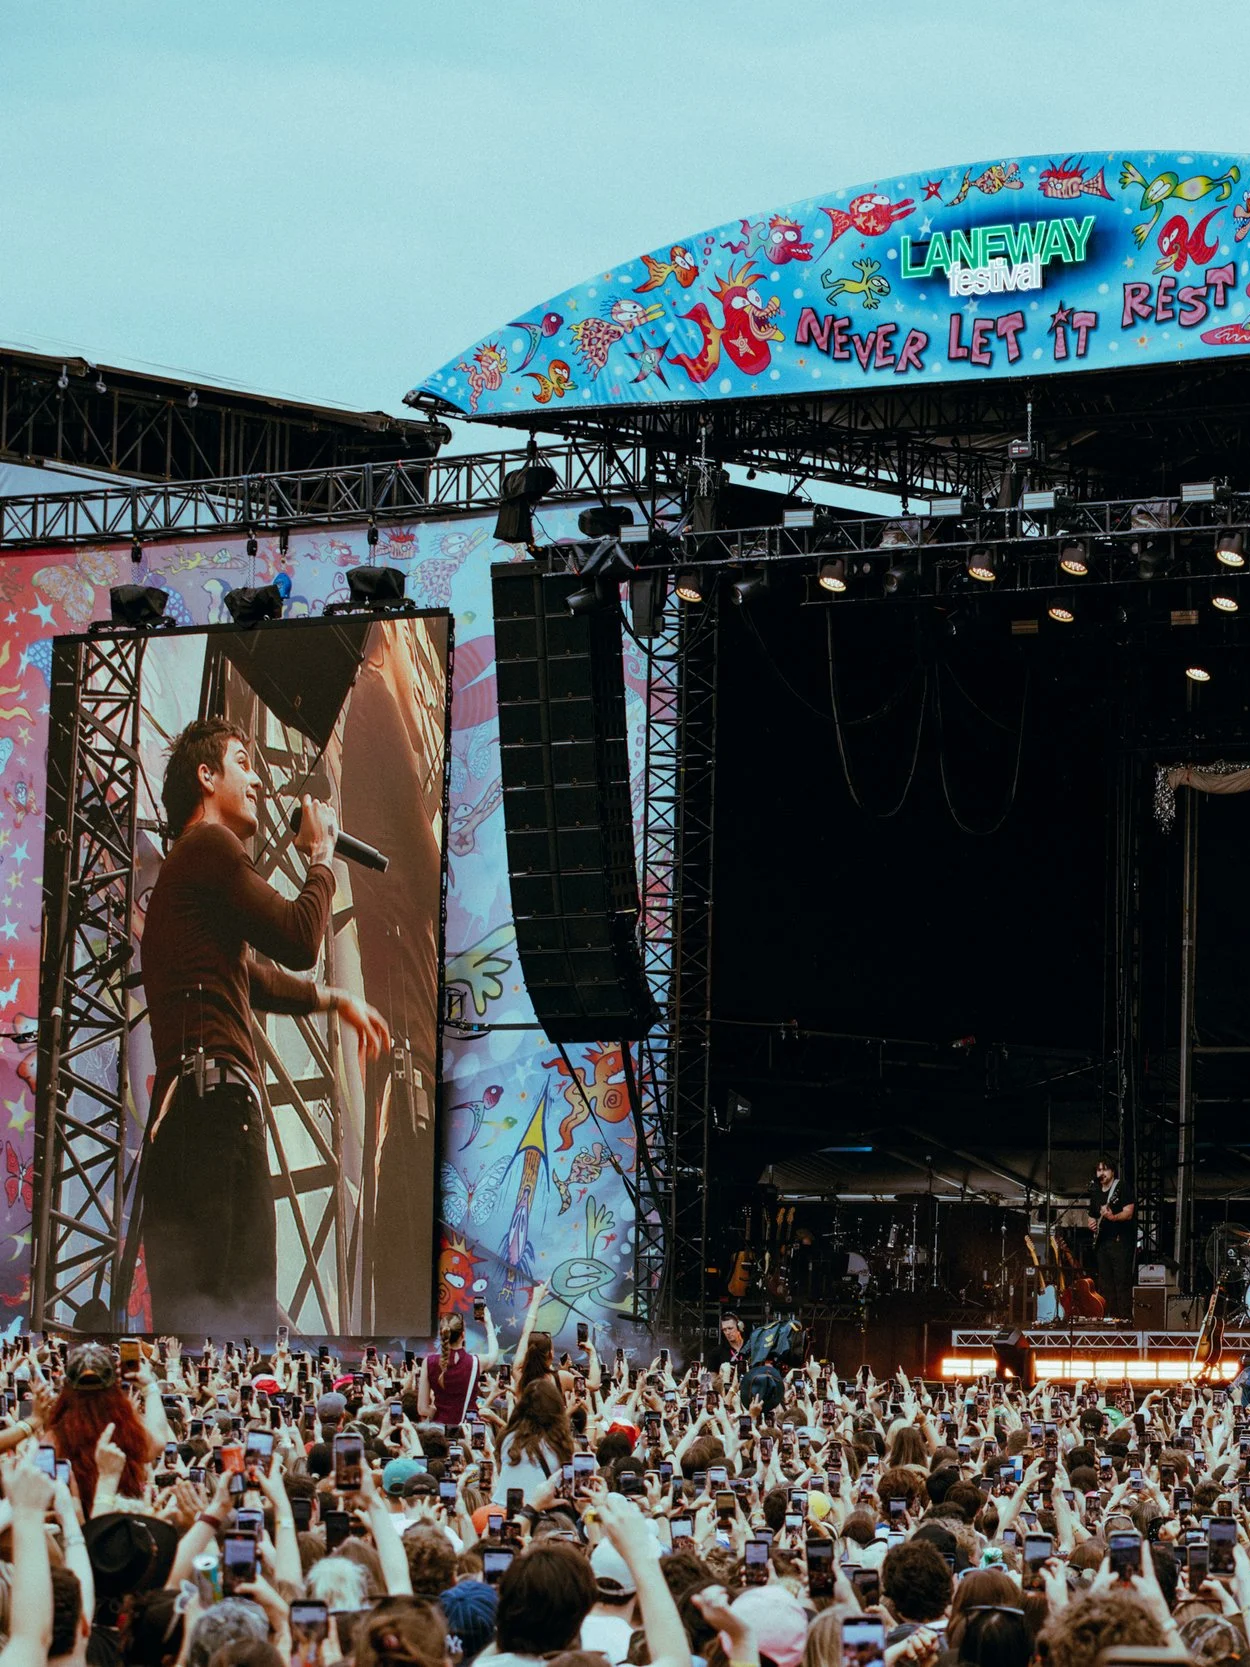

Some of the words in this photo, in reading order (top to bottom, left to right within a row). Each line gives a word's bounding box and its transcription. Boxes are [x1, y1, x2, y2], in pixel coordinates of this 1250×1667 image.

[901, 216, 1094, 278] LANEWAY
[947, 253, 1043, 297] festival
[795, 306, 930, 374] NEVER
[947, 310, 1026, 367] LET
[1122, 263, 1236, 328] REST
